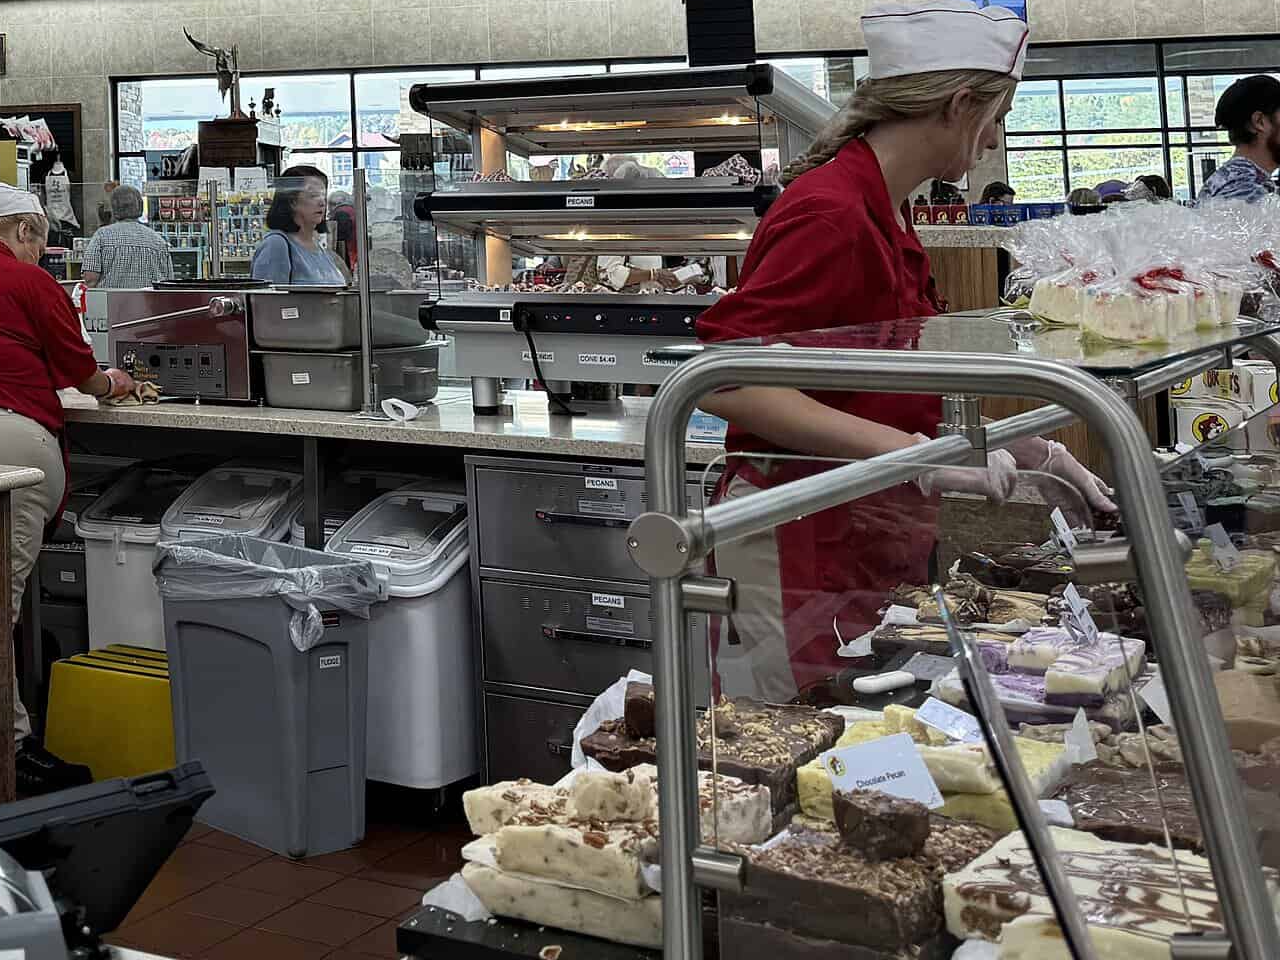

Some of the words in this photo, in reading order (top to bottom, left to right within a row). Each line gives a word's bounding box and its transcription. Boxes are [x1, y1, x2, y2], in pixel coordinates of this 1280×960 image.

[586, 478, 615, 488] PECANS
[593, 595, 622, 606] PECANS
[855, 775, 887, 789] Chocolate
[886, 769, 906, 781] Pecan
